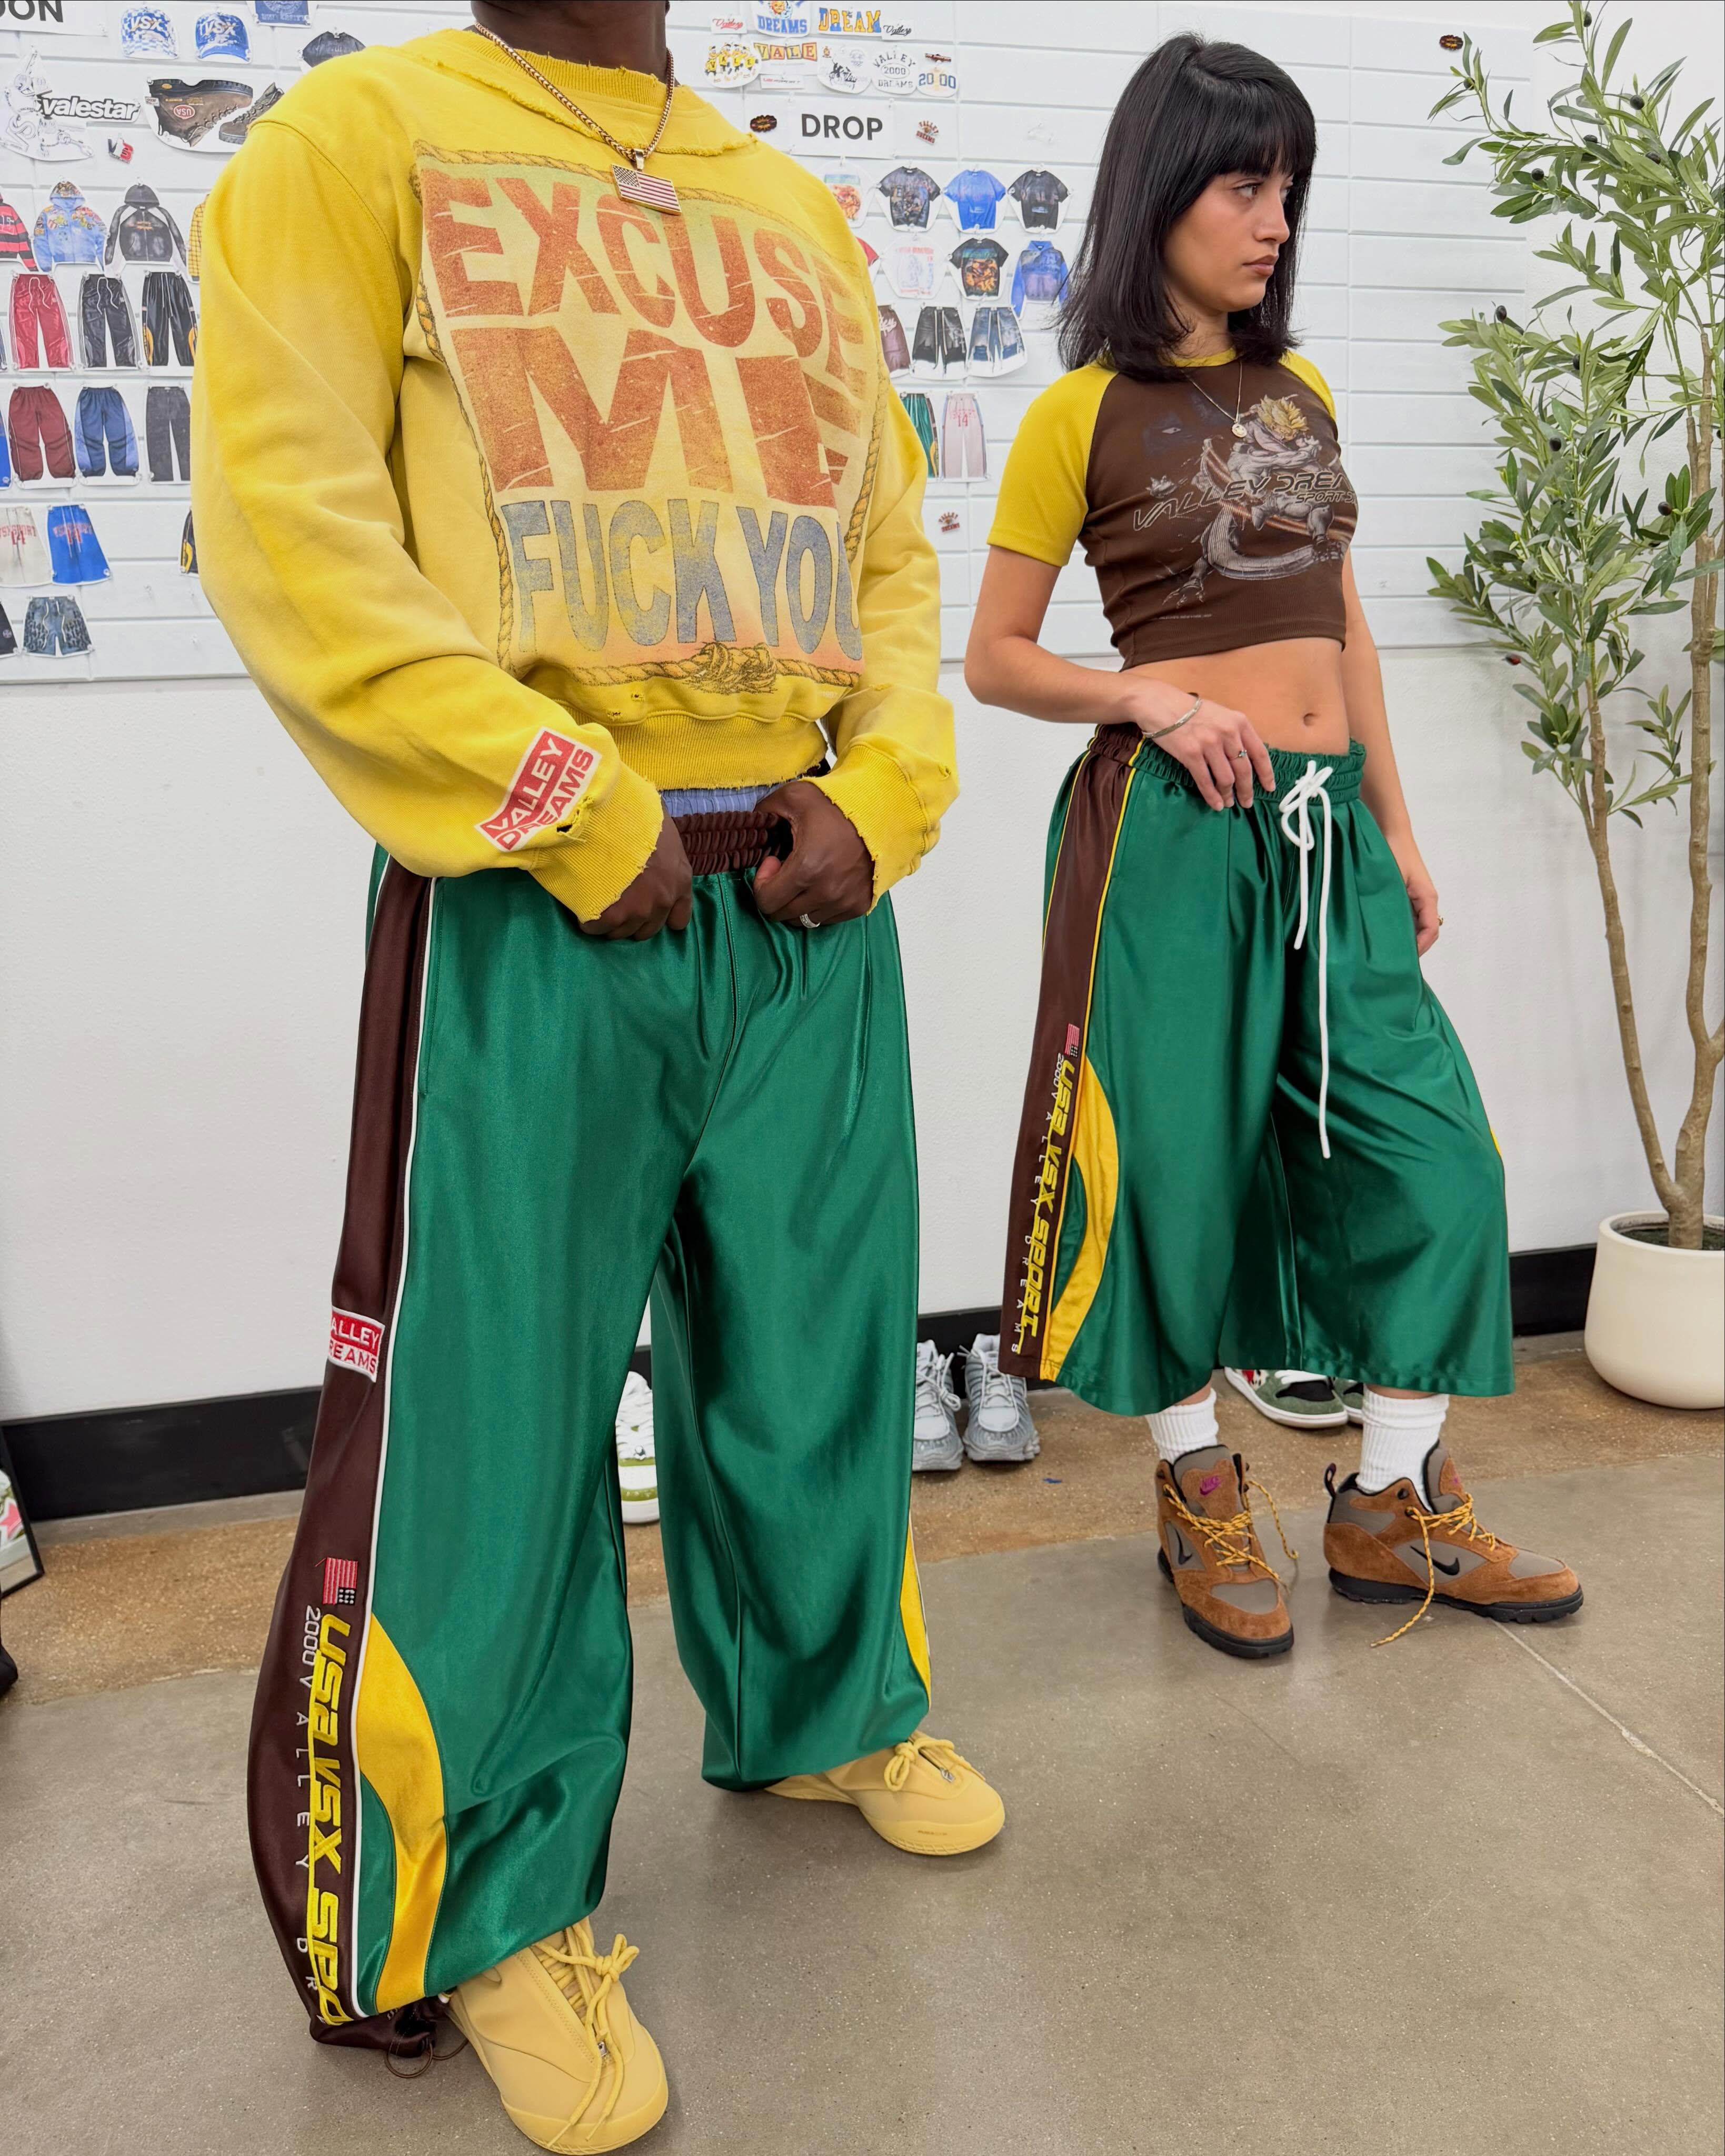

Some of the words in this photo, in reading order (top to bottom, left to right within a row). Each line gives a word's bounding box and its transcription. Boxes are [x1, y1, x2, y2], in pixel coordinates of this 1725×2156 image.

[0, 1, 64, 23] ON
[757, 14, 807, 34] DREAMS
[819, 7, 882, 33] DREAM
[755, 43, 815, 60] VALE
[872, 51, 916, 68] VALLEY
[884, 66, 906, 75] 2000
[42, 96, 139, 120] valestar
[801, 113, 883, 141] DROP
[421, 168, 867, 401] EXCUSE
[450, 325, 861, 510] ME
[1133, 476, 1271, 532] VALLEY
[1295, 491, 1344, 504] SPORT
[500, 498, 736, 654] FUCK
[486, 737, 563, 830] VALLEY
[496, 748, 594, 851] DREAMS
